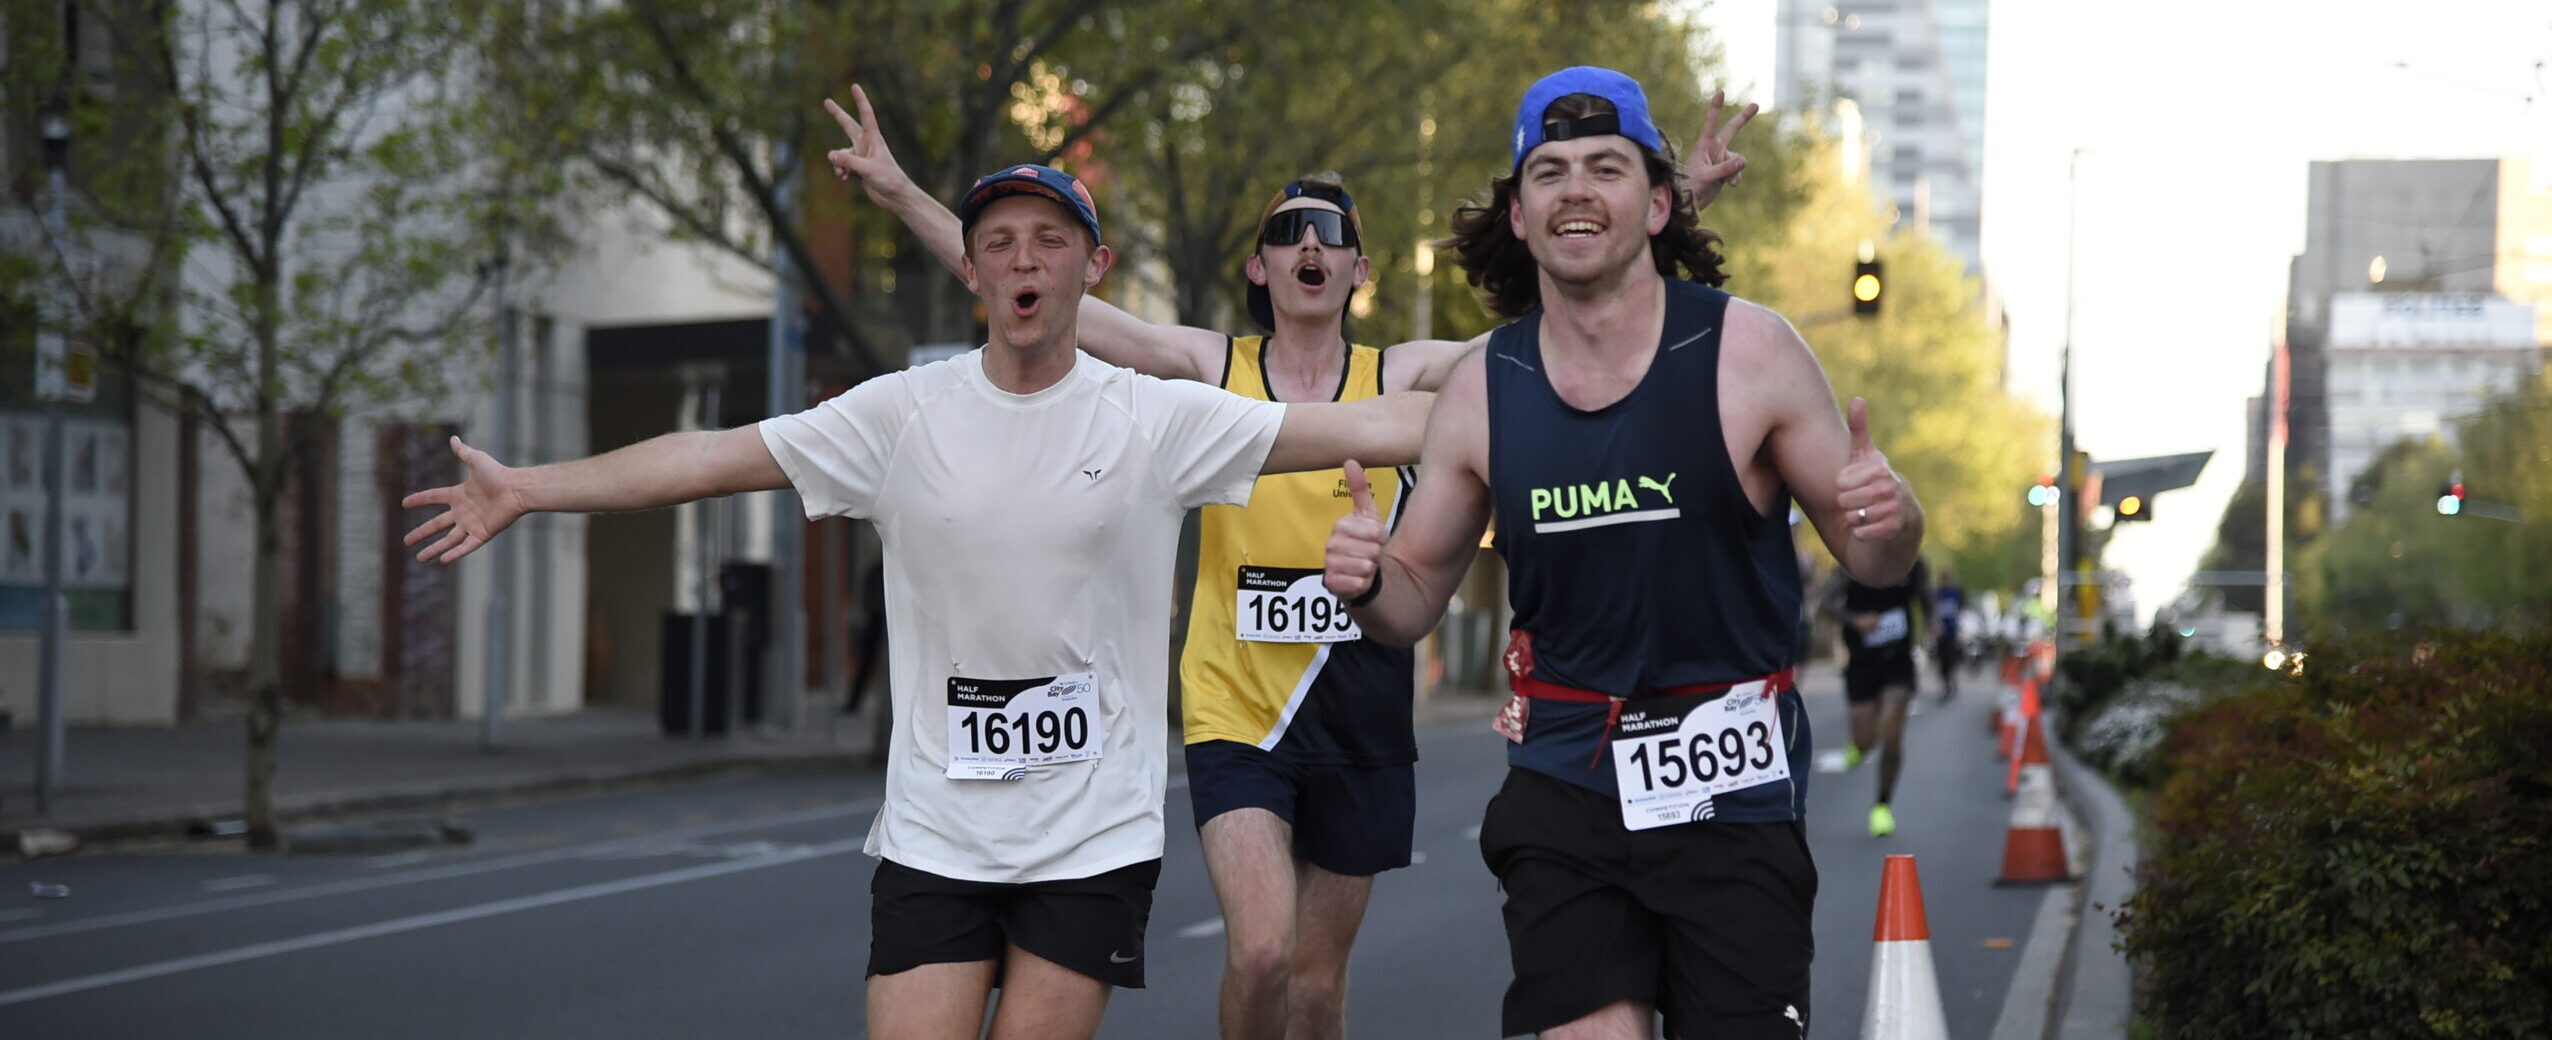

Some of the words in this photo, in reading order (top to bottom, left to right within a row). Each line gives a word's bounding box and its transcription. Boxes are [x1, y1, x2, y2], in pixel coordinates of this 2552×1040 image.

[1531, 478, 1639, 520] PUMA
[1246, 578, 1287, 587] MARATHON
[1249, 594, 1353, 633] 16195
[957, 684, 979, 693] HALF
[1077, 682, 1091, 694] 50
[957, 693, 1006, 702] MARATHON
[1620, 711, 1647, 723] HALF
[961, 706, 1088, 754] 16190
[1622, 716, 1679, 732] MARATHON
[1630, 720, 1774, 792] 15693
[1657, 810, 1681, 821] 15693
